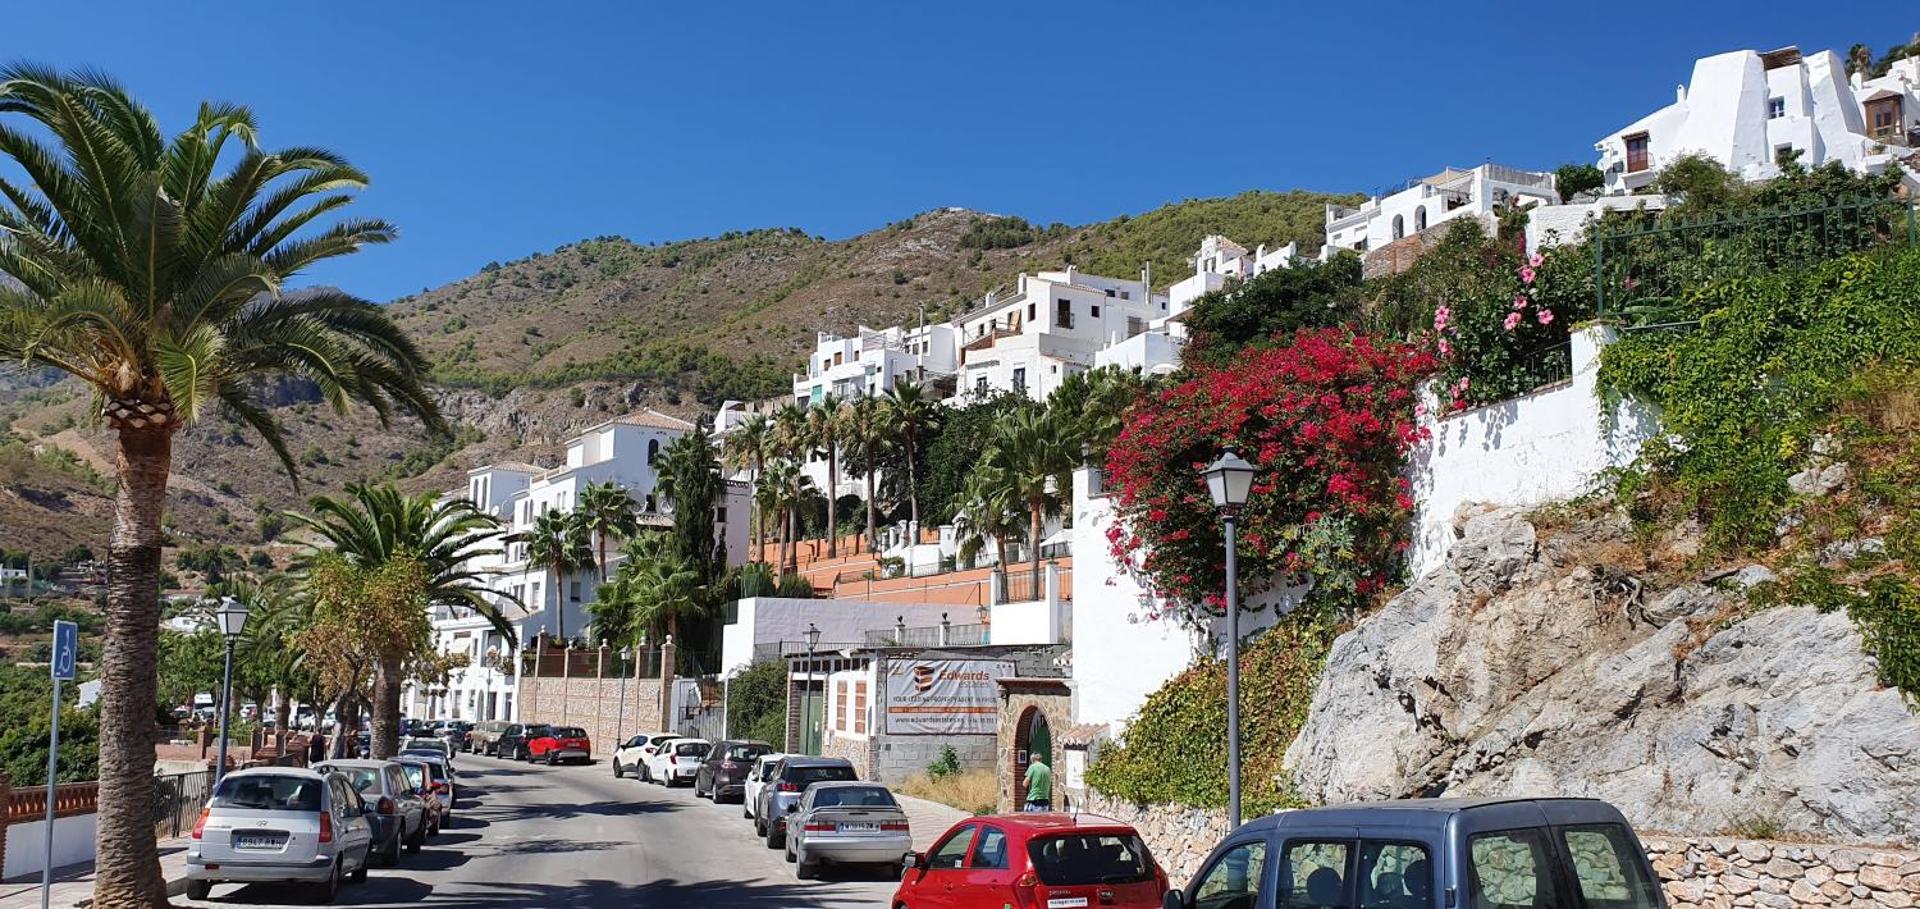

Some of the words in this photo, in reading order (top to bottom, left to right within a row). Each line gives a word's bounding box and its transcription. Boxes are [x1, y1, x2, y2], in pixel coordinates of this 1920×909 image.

[939, 671, 990, 681] Edwards
[958, 681, 989, 689] estates
[893, 695, 907, 703] YOUR
